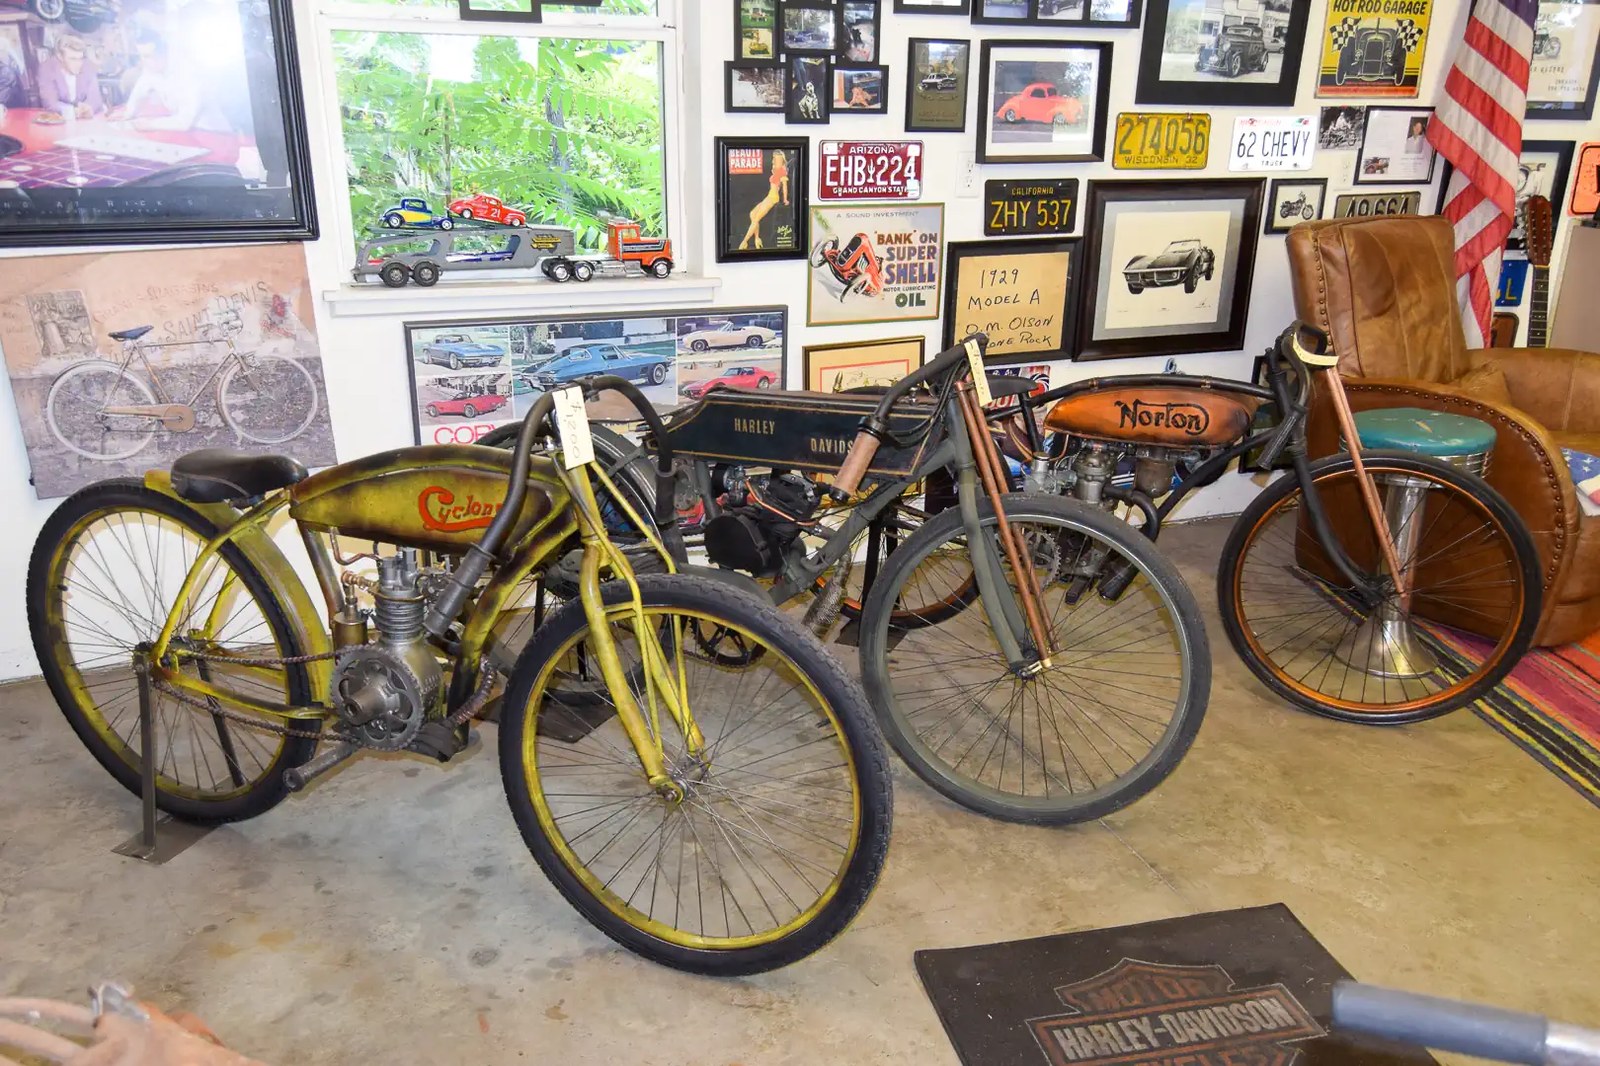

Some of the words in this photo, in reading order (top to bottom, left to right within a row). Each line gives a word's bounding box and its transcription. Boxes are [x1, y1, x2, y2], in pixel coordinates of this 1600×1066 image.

[1333, 0, 1357, 12] HOT
[1358, 0, 1381, 13] ROD
[1384, 0, 1428, 15] GARAGE
[1119, 117, 1207, 155] 274056
[1237, 131, 1257, 158] 62
[1262, 130, 1311, 157] CHEVY
[849, 146, 895, 154] ARIZONA
[730, 158, 762, 168] PARADE
[1125, 155, 1179, 164] WISCONSIN
[1185, 156, 1198, 164] 32
[825, 155, 867, 187] EHB
[876, 155, 916, 186] 224
[1011, 187, 1054, 196] CALIFORNIA
[990, 201, 1031, 228] ZHY
[1037, 199, 1072, 226] 537
[919, 233, 938, 244] ON
[886, 245, 937, 262] SUPER
[884, 262, 936, 285] SHELL
[980, 268, 1019, 289] 1929
[895, 293, 926, 308] OIL
[968, 293, 1020, 310] MODEL
[1029, 288, 1040, 305] A
[986, 337, 1014, 349] ONE
[734, 417, 775, 435] HARLEY
[1114, 399, 1210, 436] Norton
[434, 423, 497, 445] COR
[810, 438, 853, 454] DAVIDS
[1052, 998, 1298, 1061] HARLEY-DAVIDSON
